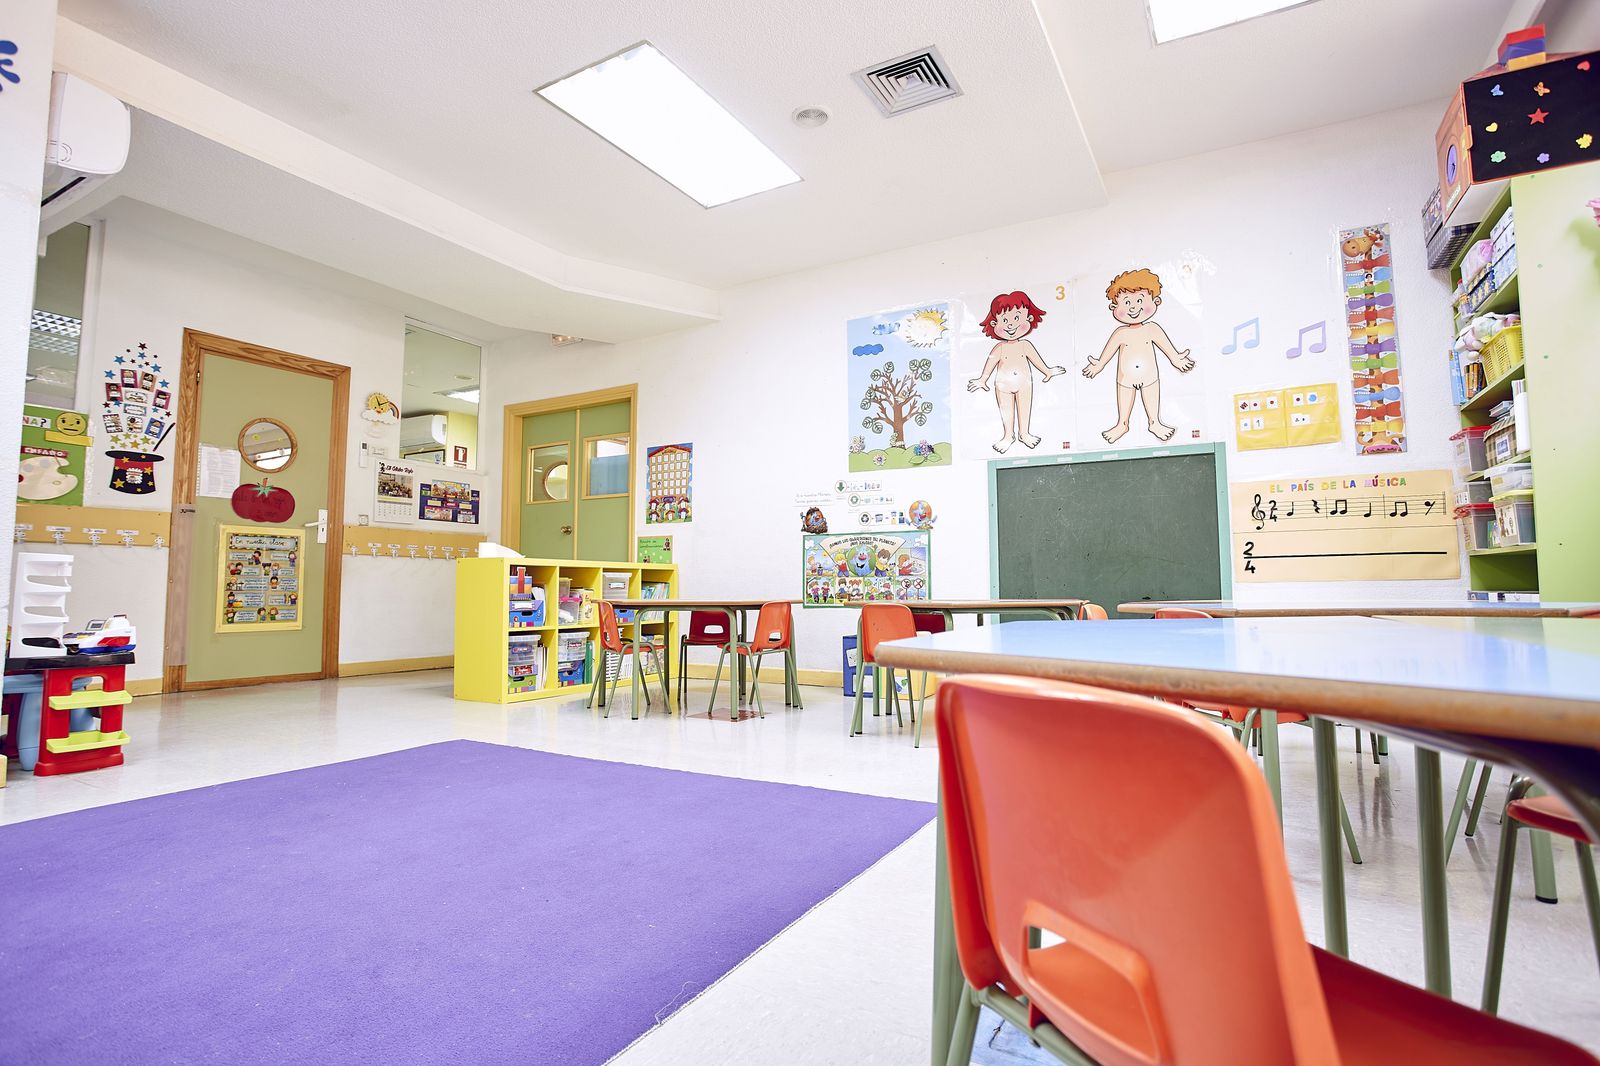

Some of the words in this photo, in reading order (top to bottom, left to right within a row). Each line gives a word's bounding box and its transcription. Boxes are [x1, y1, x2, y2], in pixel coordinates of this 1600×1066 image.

[1055, 285, 1065, 300] 3
[1269, 484, 1284, 493] EL
[1291, 479, 1315, 491] PAÍS
[1321, 481, 1337, 490] DE
[1343, 480, 1356, 488] LA
[1364, 475, 1407, 487] MÚSICA
[1243, 541, 1255, 556] 2
[1244, 560, 1256, 574] 4
